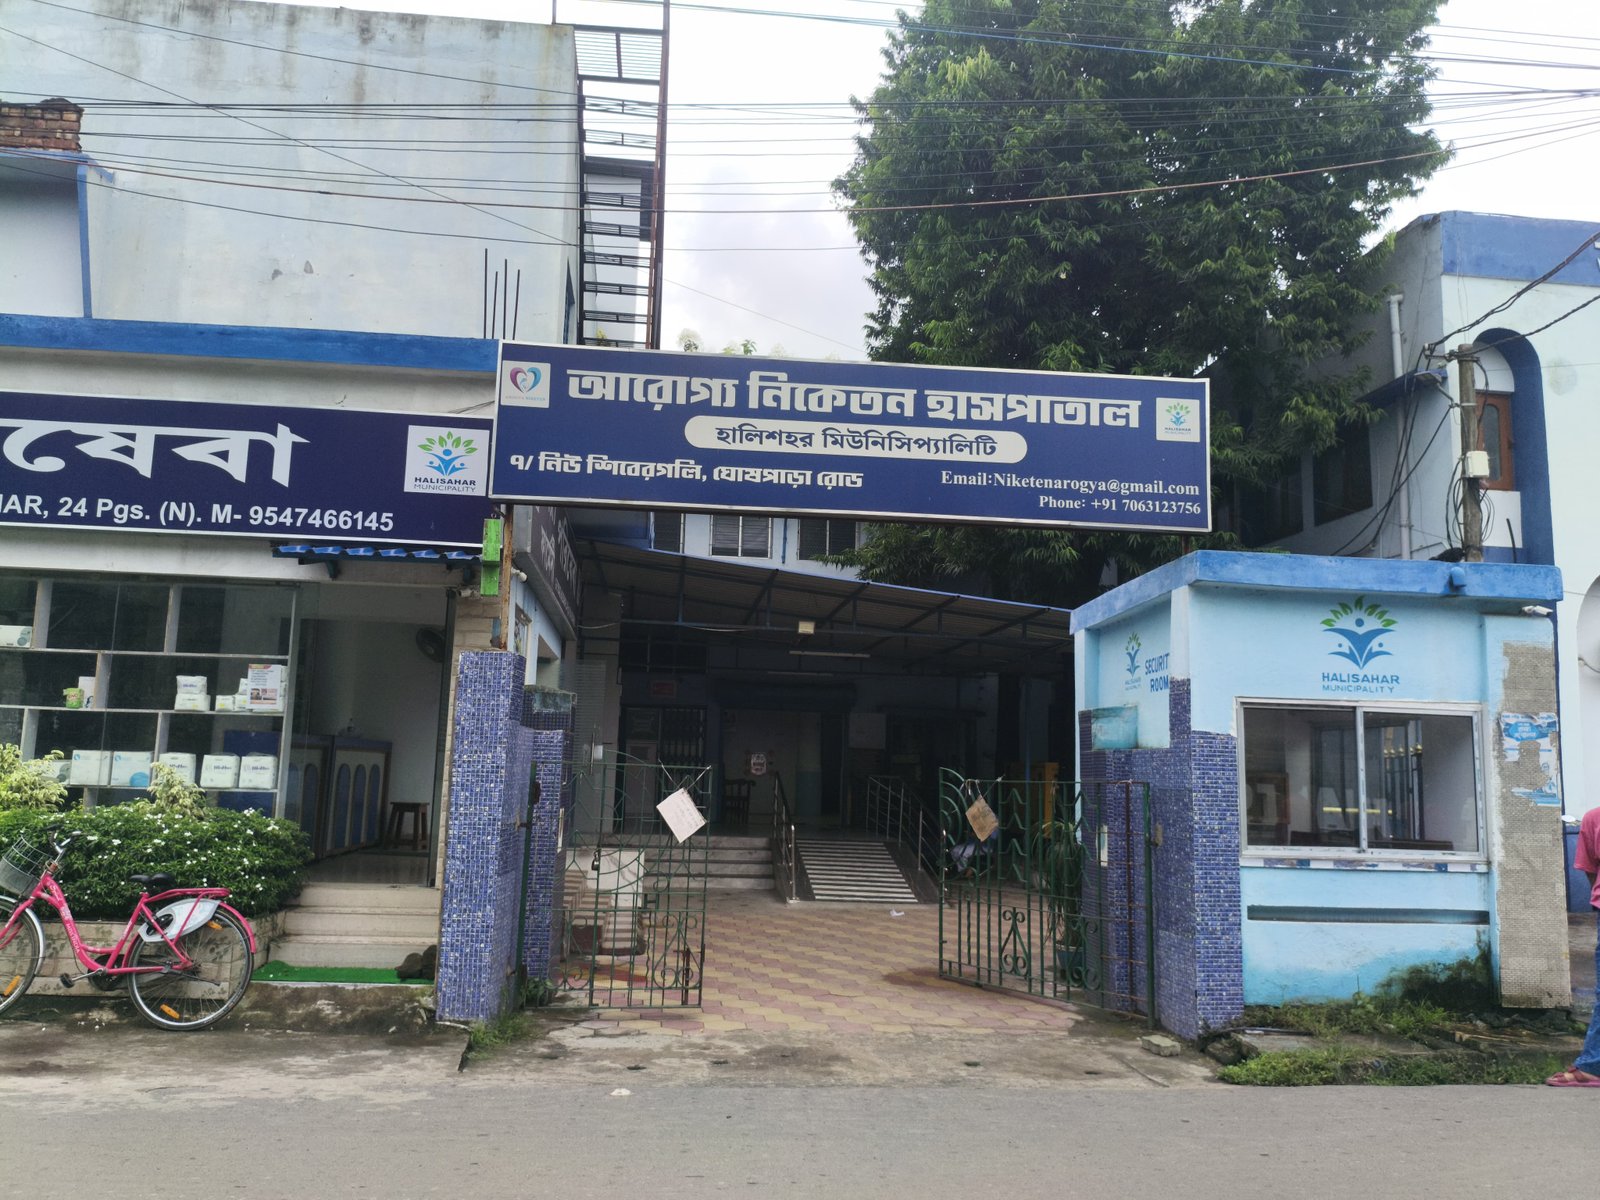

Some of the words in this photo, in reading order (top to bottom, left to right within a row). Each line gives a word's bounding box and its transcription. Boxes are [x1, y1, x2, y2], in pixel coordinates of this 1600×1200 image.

[566, 369, 739, 411] আরোগ্য
[747, 371, 917, 418] নিকেতন
[924, 389, 1142, 429] হাসপাতাল
[715, 423, 815, 448] হালিশহর
[821, 427, 998, 456] মিউনিসিপ্যালিটি
[0, 418, 311, 488] ষেবা
[538, 451, 583, 474] নিউ
[713, 466, 813, 489] ঘোষপাড়া
[817, 471, 864, 490] রোড
[413, 483, 477, 493] MUNICIPALITY
[414, 477, 477, 486] HALISAHAR
[0, 494, 49, 519] AR,
[57, 497, 88, 517] 24
[96, 498, 151, 524] Pgs.
[159, 500, 202, 526] (N).
[211, 503, 242, 524] M-
[249, 506, 394, 532] 9547466145
[1039, 496, 1086, 510] Phone:
[1091, 499, 1118, 511] +91
[1122, 499, 1201, 514] 7063123756
[1150, 675, 1169, 692] ROOM
[1321, 672, 1400, 685] HALISAHAR
[1321, 684, 1395, 693] MUNICIPALITY
